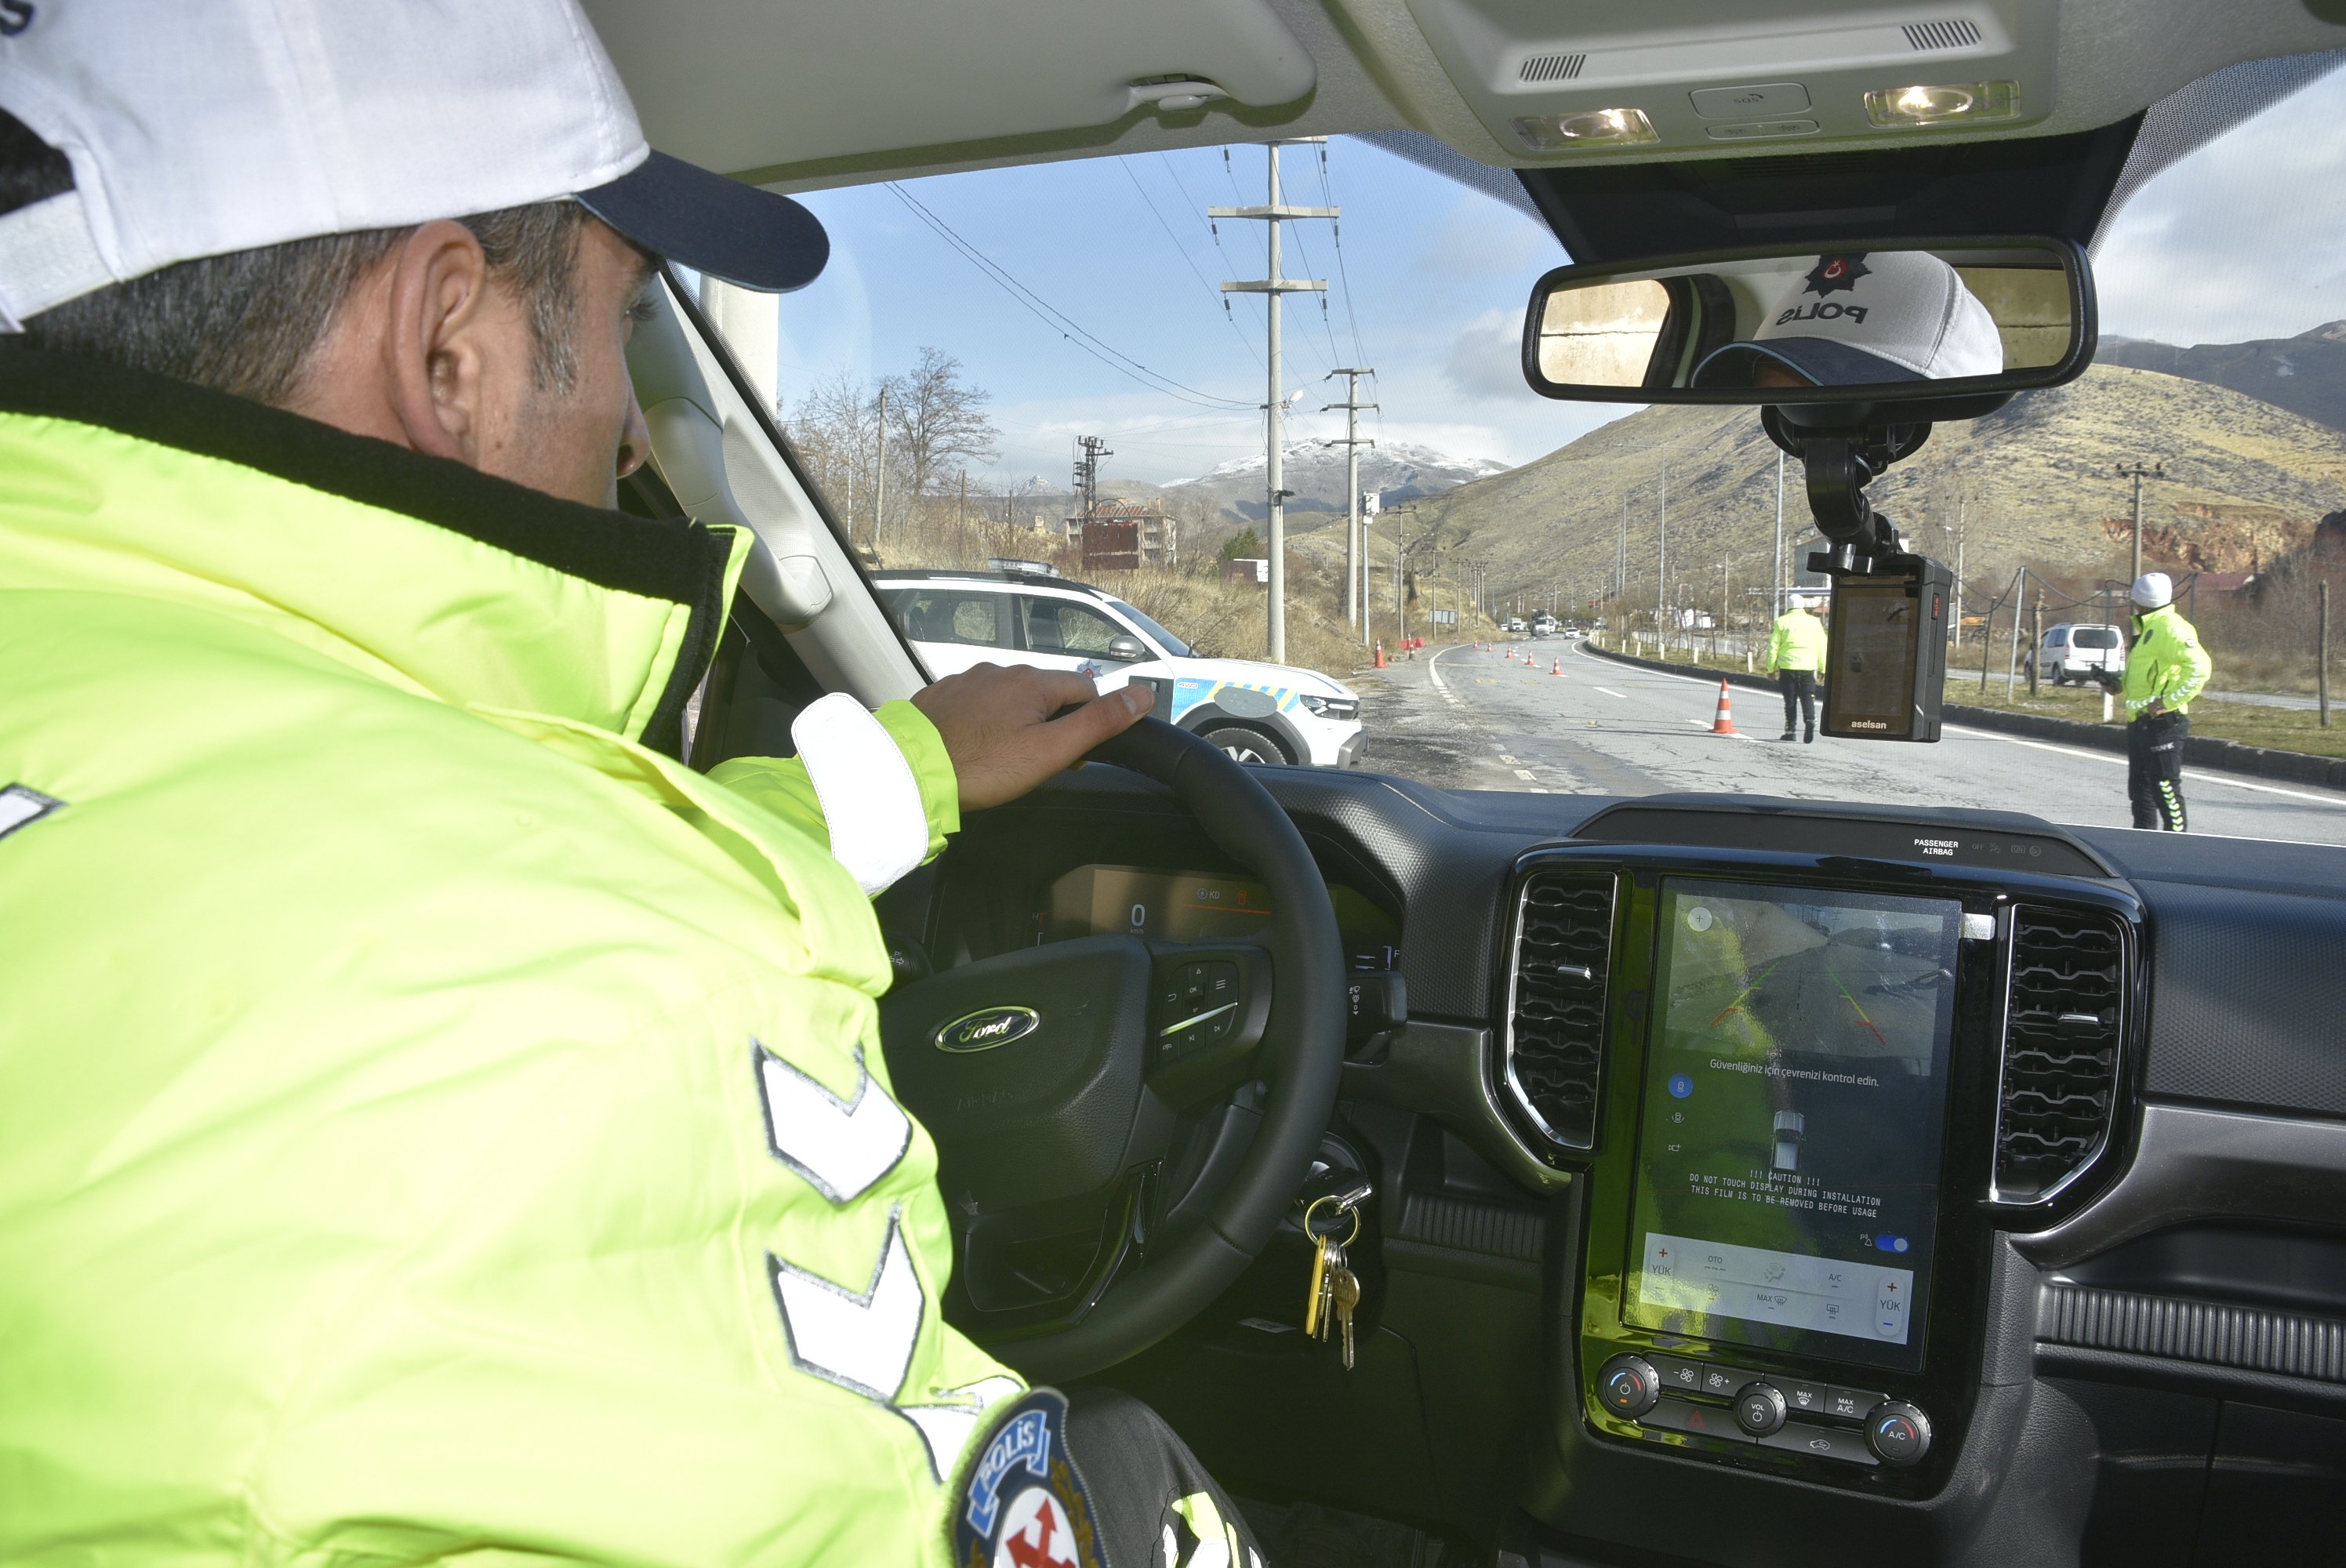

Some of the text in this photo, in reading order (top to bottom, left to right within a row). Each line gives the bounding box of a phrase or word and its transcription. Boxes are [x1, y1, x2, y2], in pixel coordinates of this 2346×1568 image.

[1851, 720, 1887, 729] aselsan
[1914, 839, 1959, 848] PASSENGER
[1131, 903, 1146, 927] 0
[959, 1015, 1012, 1043] Ford
[1710, 1058, 1879, 1087] Güvenliğiniz için çevrenizi kontrol edin.
[1768, 1171, 1802, 1184] CAUTION
[1690, 1173, 1881, 1206] DO NOT TOUCH DISPLAY DURING INSTALLATION
[1691, 1185, 1877, 1218] THIS FILM IS TO BE REMOVED BEFORE USAGE
[1708, 1255, 1723, 1264] OTO
[1651, 1264, 1672, 1276] YÜK
[1828, 1273, 1841, 1282] A/C
[1756, 1294, 1773, 1303] MAX
[1880, 1299, 1901, 1312] YÜK
[1796, 1390, 1812, 1399] MAX
[1837, 1405, 1854, 1414] A/C
[1888, 1431, 1906, 1440] A/C
